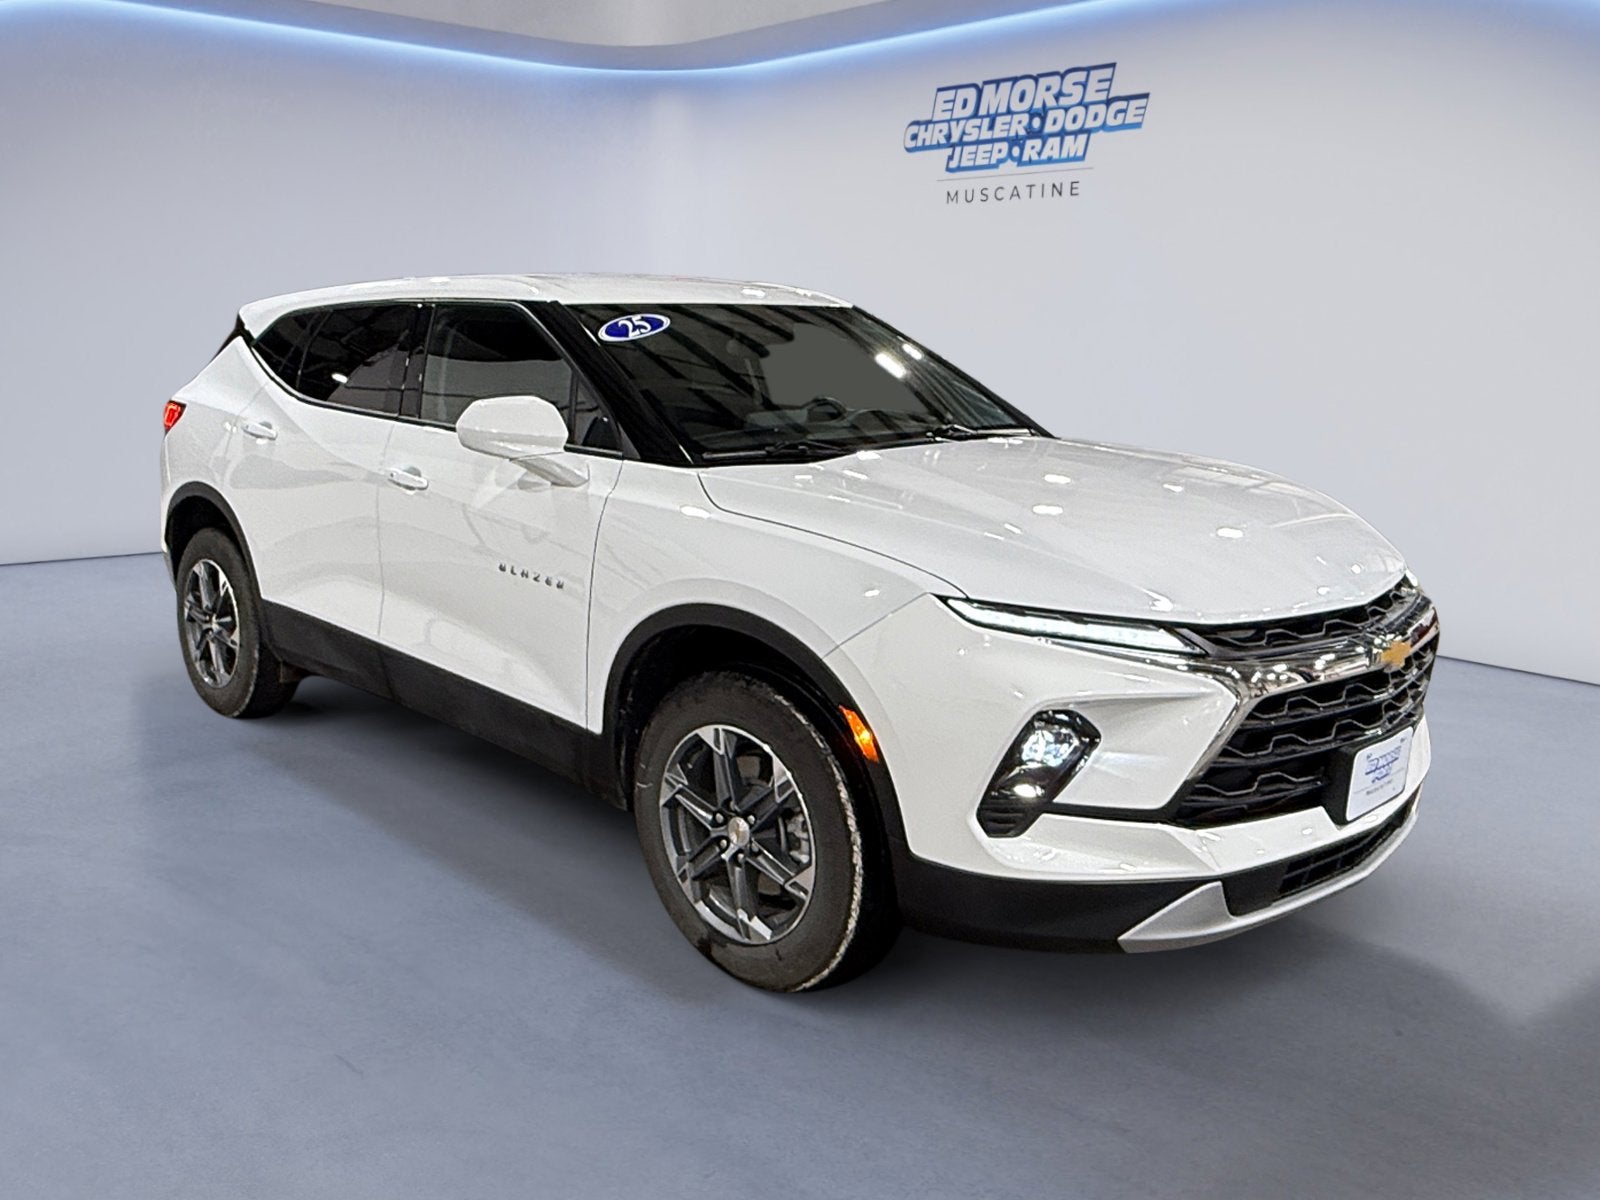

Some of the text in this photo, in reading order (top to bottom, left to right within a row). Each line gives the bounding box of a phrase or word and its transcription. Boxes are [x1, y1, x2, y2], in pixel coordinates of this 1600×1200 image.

[932, 66, 1115, 122] ED MORSE
[904, 97, 1149, 149] CHRYSLER DODGE
[948, 133, 1089, 169] JEEP RAM
[946, 181, 1080, 204] MUSCATINE
[617, 315, 652, 338] 25
